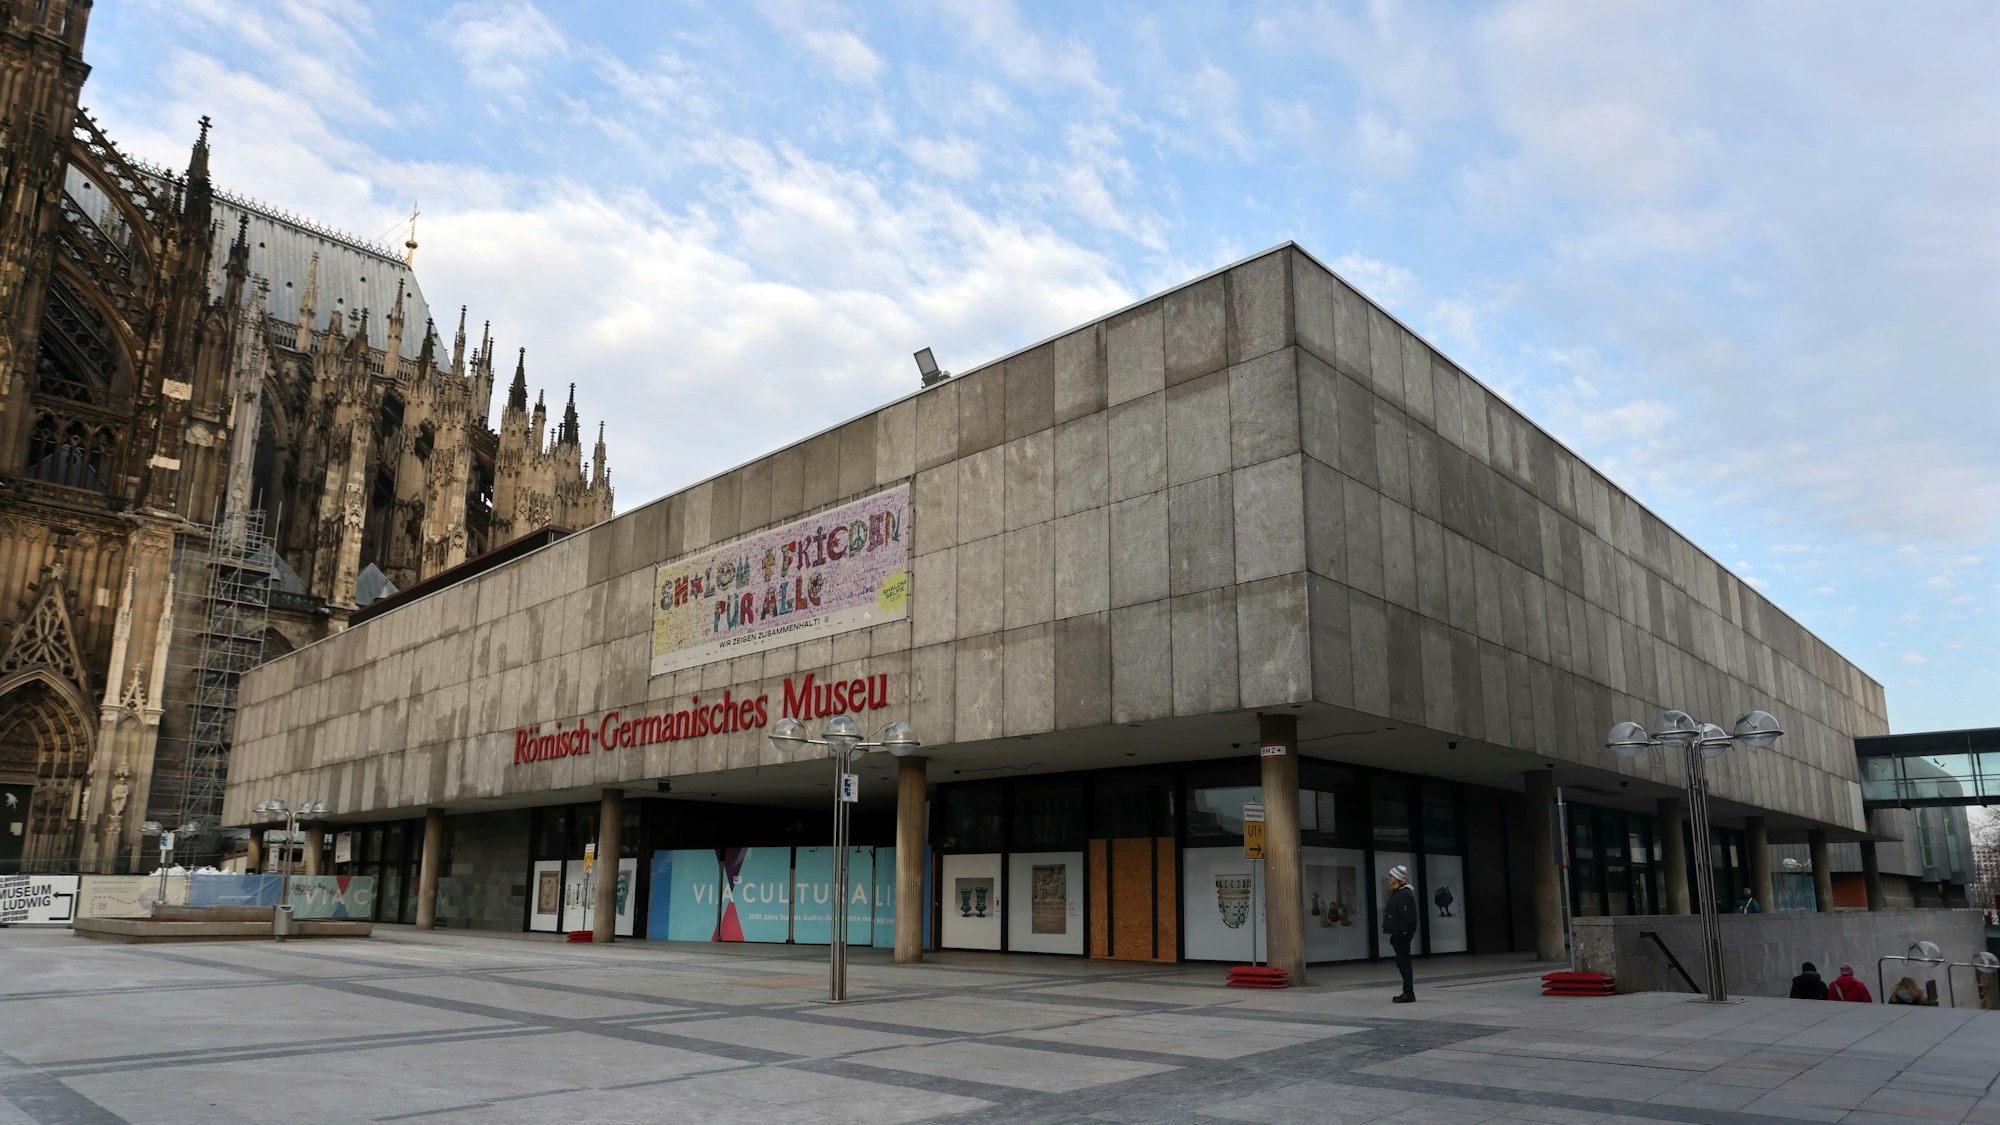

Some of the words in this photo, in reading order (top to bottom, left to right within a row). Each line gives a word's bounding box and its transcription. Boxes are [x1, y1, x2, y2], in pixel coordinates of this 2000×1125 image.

[781, 506, 902, 577] FRIEDEN
[714, 592, 754, 632] FÜR
[760, 572, 824, 620] ALLE
[719, 640, 731, 648] WIR
[733, 634, 757, 645] ZEIGEN
[758, 618, 821, 640] ZUSAMMENHALT!
[513, 690, 768, 765] Römisch-Germanisches
[783, 673, 888, 721] Museu
[0, 884, 52, 899] MUSEUM
[3, 896, 51, 910] LUDWIG
[693, 883, 739, 904] VIA
[742, 883, 897, 907] CULTURALI
